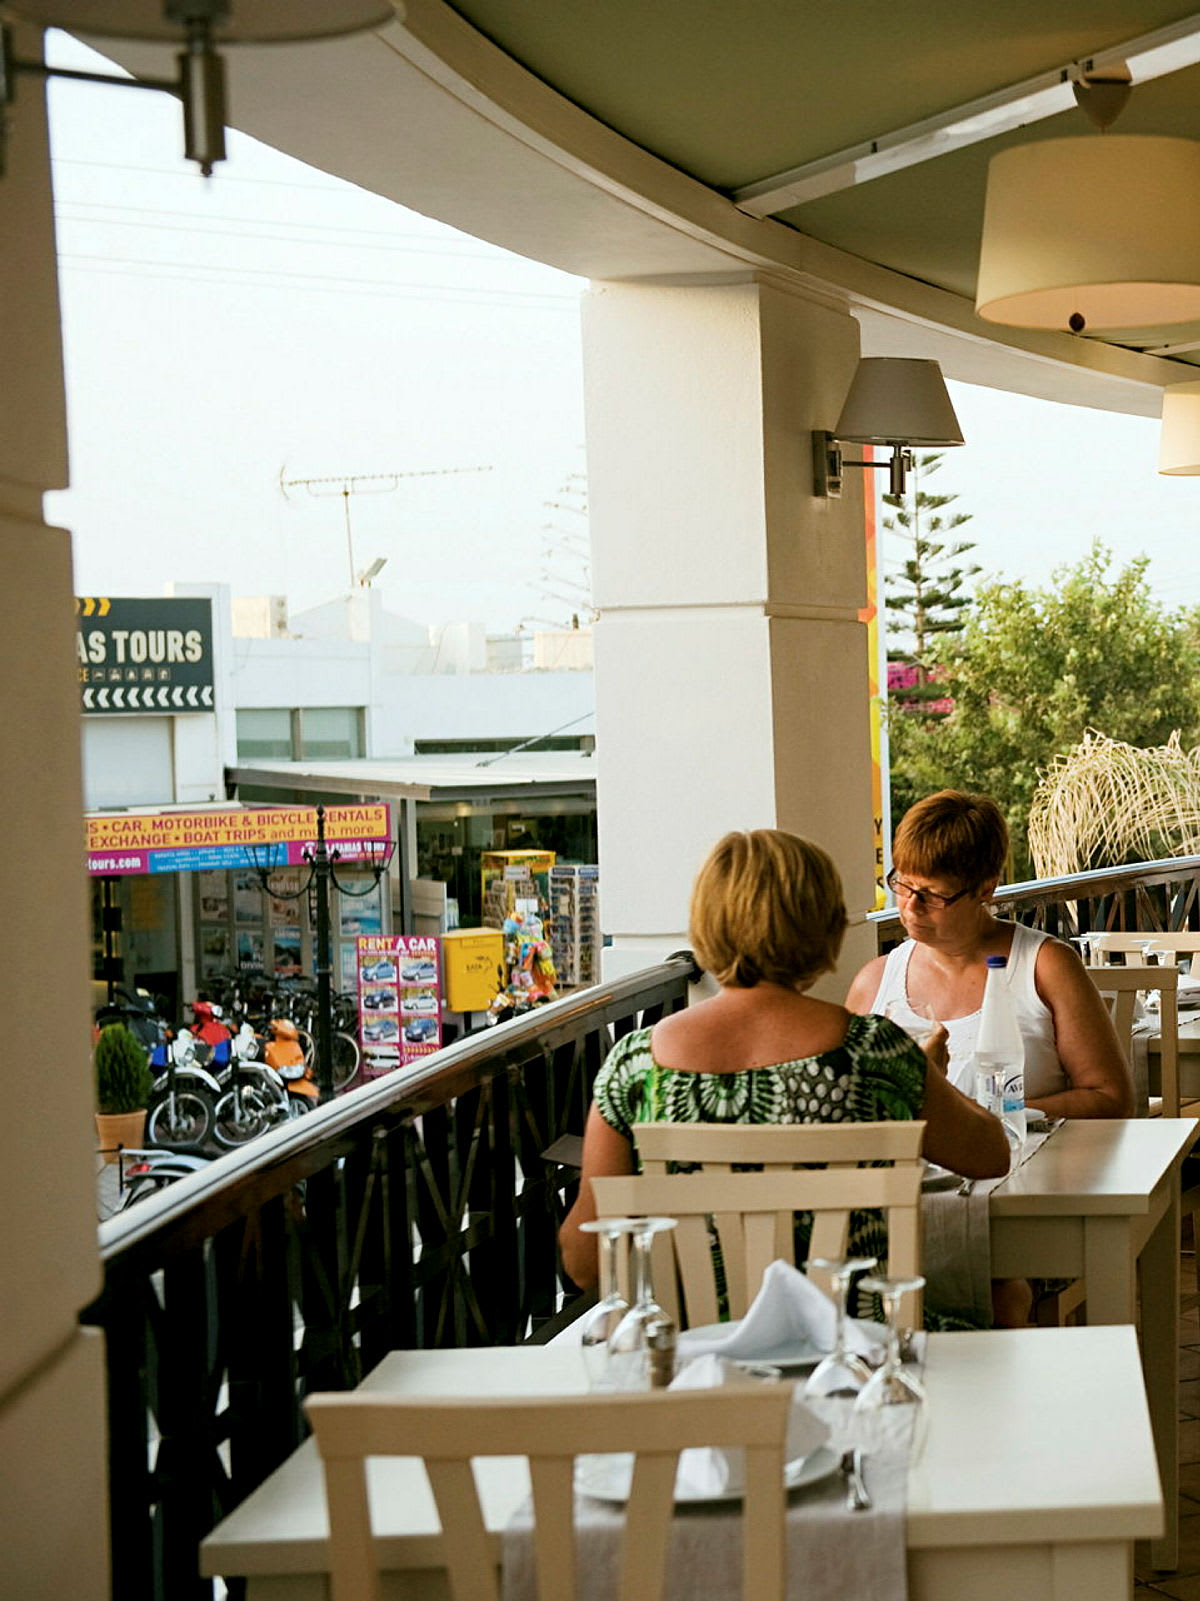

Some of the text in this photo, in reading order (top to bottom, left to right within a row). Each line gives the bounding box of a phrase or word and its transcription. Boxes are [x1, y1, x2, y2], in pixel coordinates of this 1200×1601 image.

[112, 630, 202, 663] TOURS
[151, 815, 237, 831] MOTORBIKE
[242, 814, 252, 827] &
[257, 811, 314, 826] BICYCLE
[90, 832, 171, 848] EXCHANGE
[183, 830, 220, 844] BOAT
[226, 828, 266, 842] TRIPS
[270, 827, 295, 839] and
[359, 937, 437, 951] RENT A CAR
